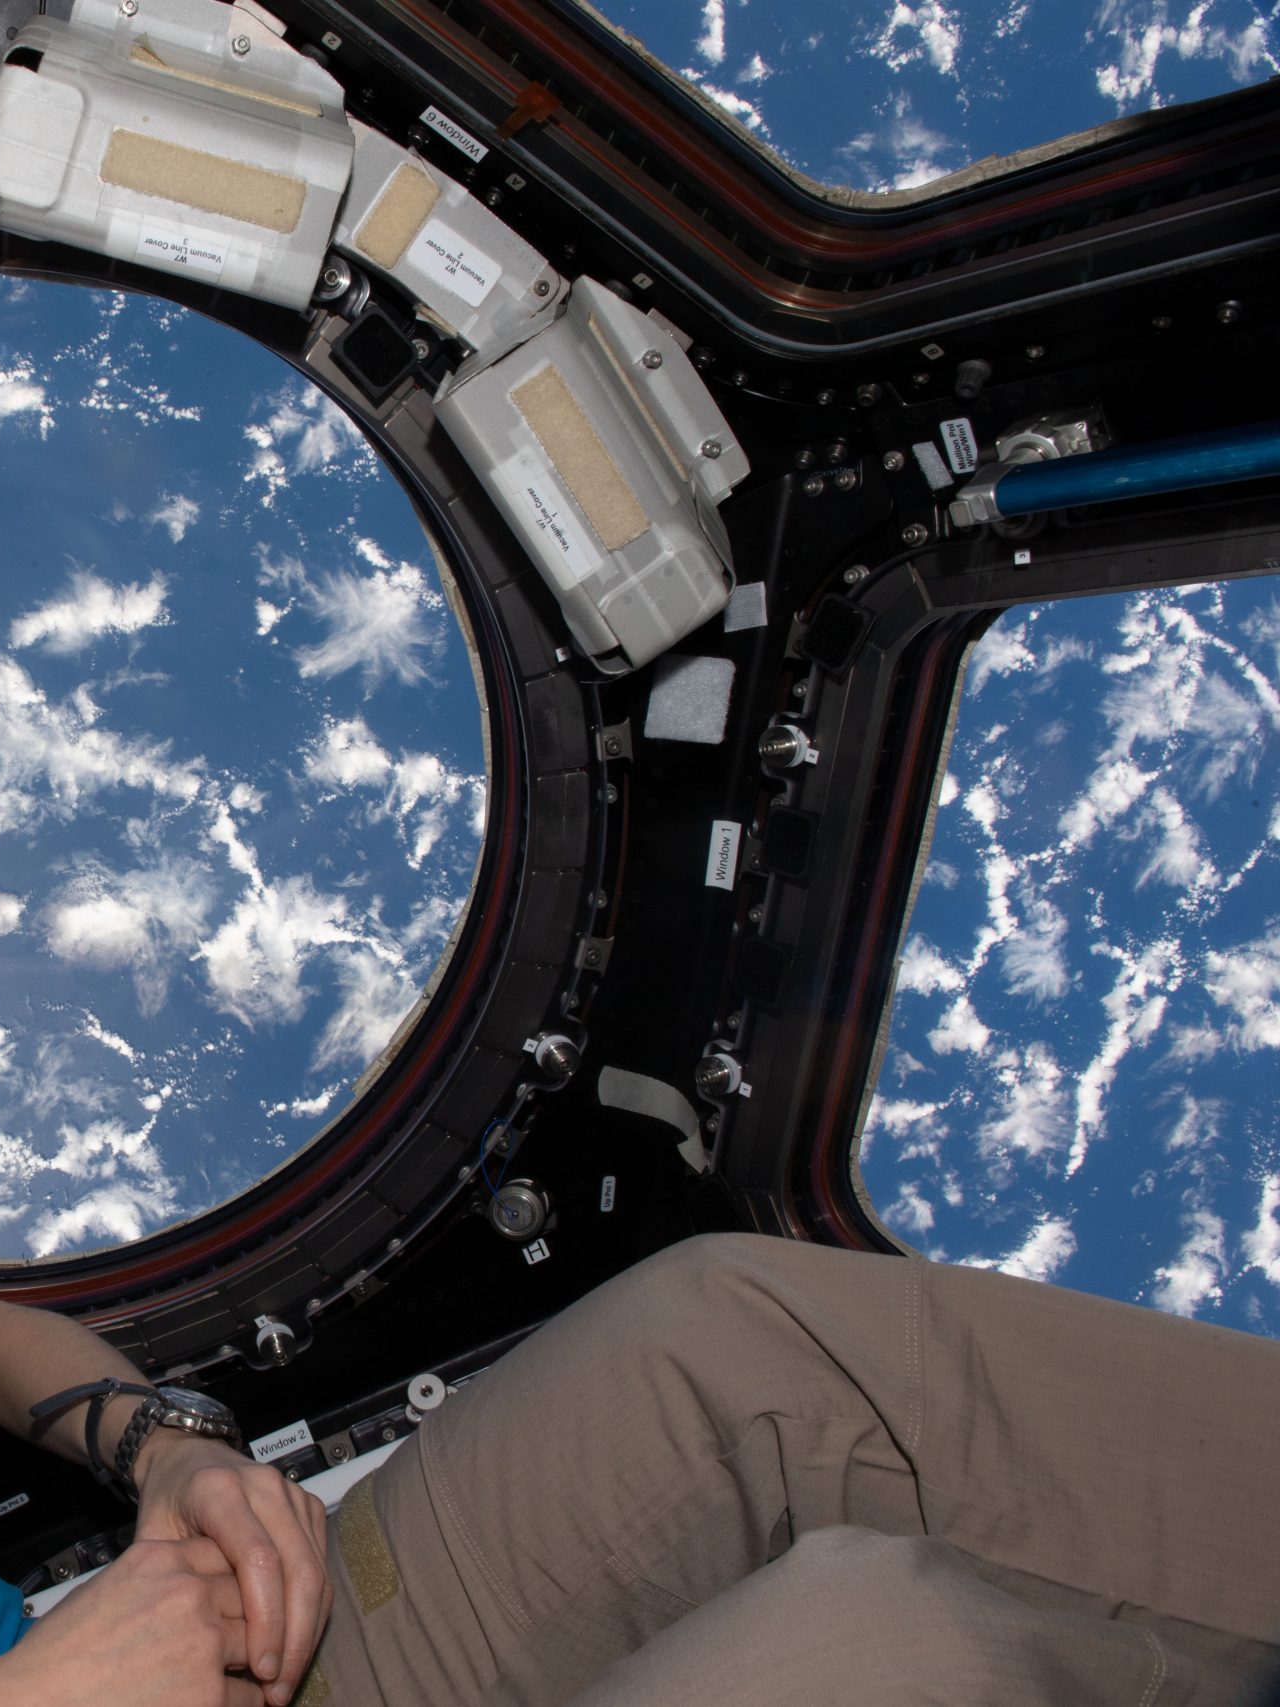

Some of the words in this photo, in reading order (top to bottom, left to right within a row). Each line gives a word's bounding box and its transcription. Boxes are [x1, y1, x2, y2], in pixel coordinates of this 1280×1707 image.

[426, 112, 437, 122] 6
[437, 120, 480, 158] Window
[144, 237, 169, 250] Cover
[170, 243, 189, 254] Line
[425, 239, 445, 256] Cover
[174, 255, 187, 264] W7
[189, 251, 222, 264] Vacuum
[445, 253, 460, 268] Line
[457, 252, 464, 260] 2
[445, 265, 457, 276] W7
[460, 263, 485, 287] Vacuum
[946, 423, 956, 437] Pnl
[952, 439, 966, 470] Mullion
[527, 487, 542, 508] Cover
[540, 505, 554, 524] Line
[550, 521, 570, 552] Vacuum
[715, 836, 730, 881] Window
[604, 1185, 612, 1196] Pnl
[604, 1197, 612, 1208] Up
[257, 1433, 297, 1457] Window
[298, 1429, 307, 1439] 2
[8, 1500, 19, 1509] Pnl
